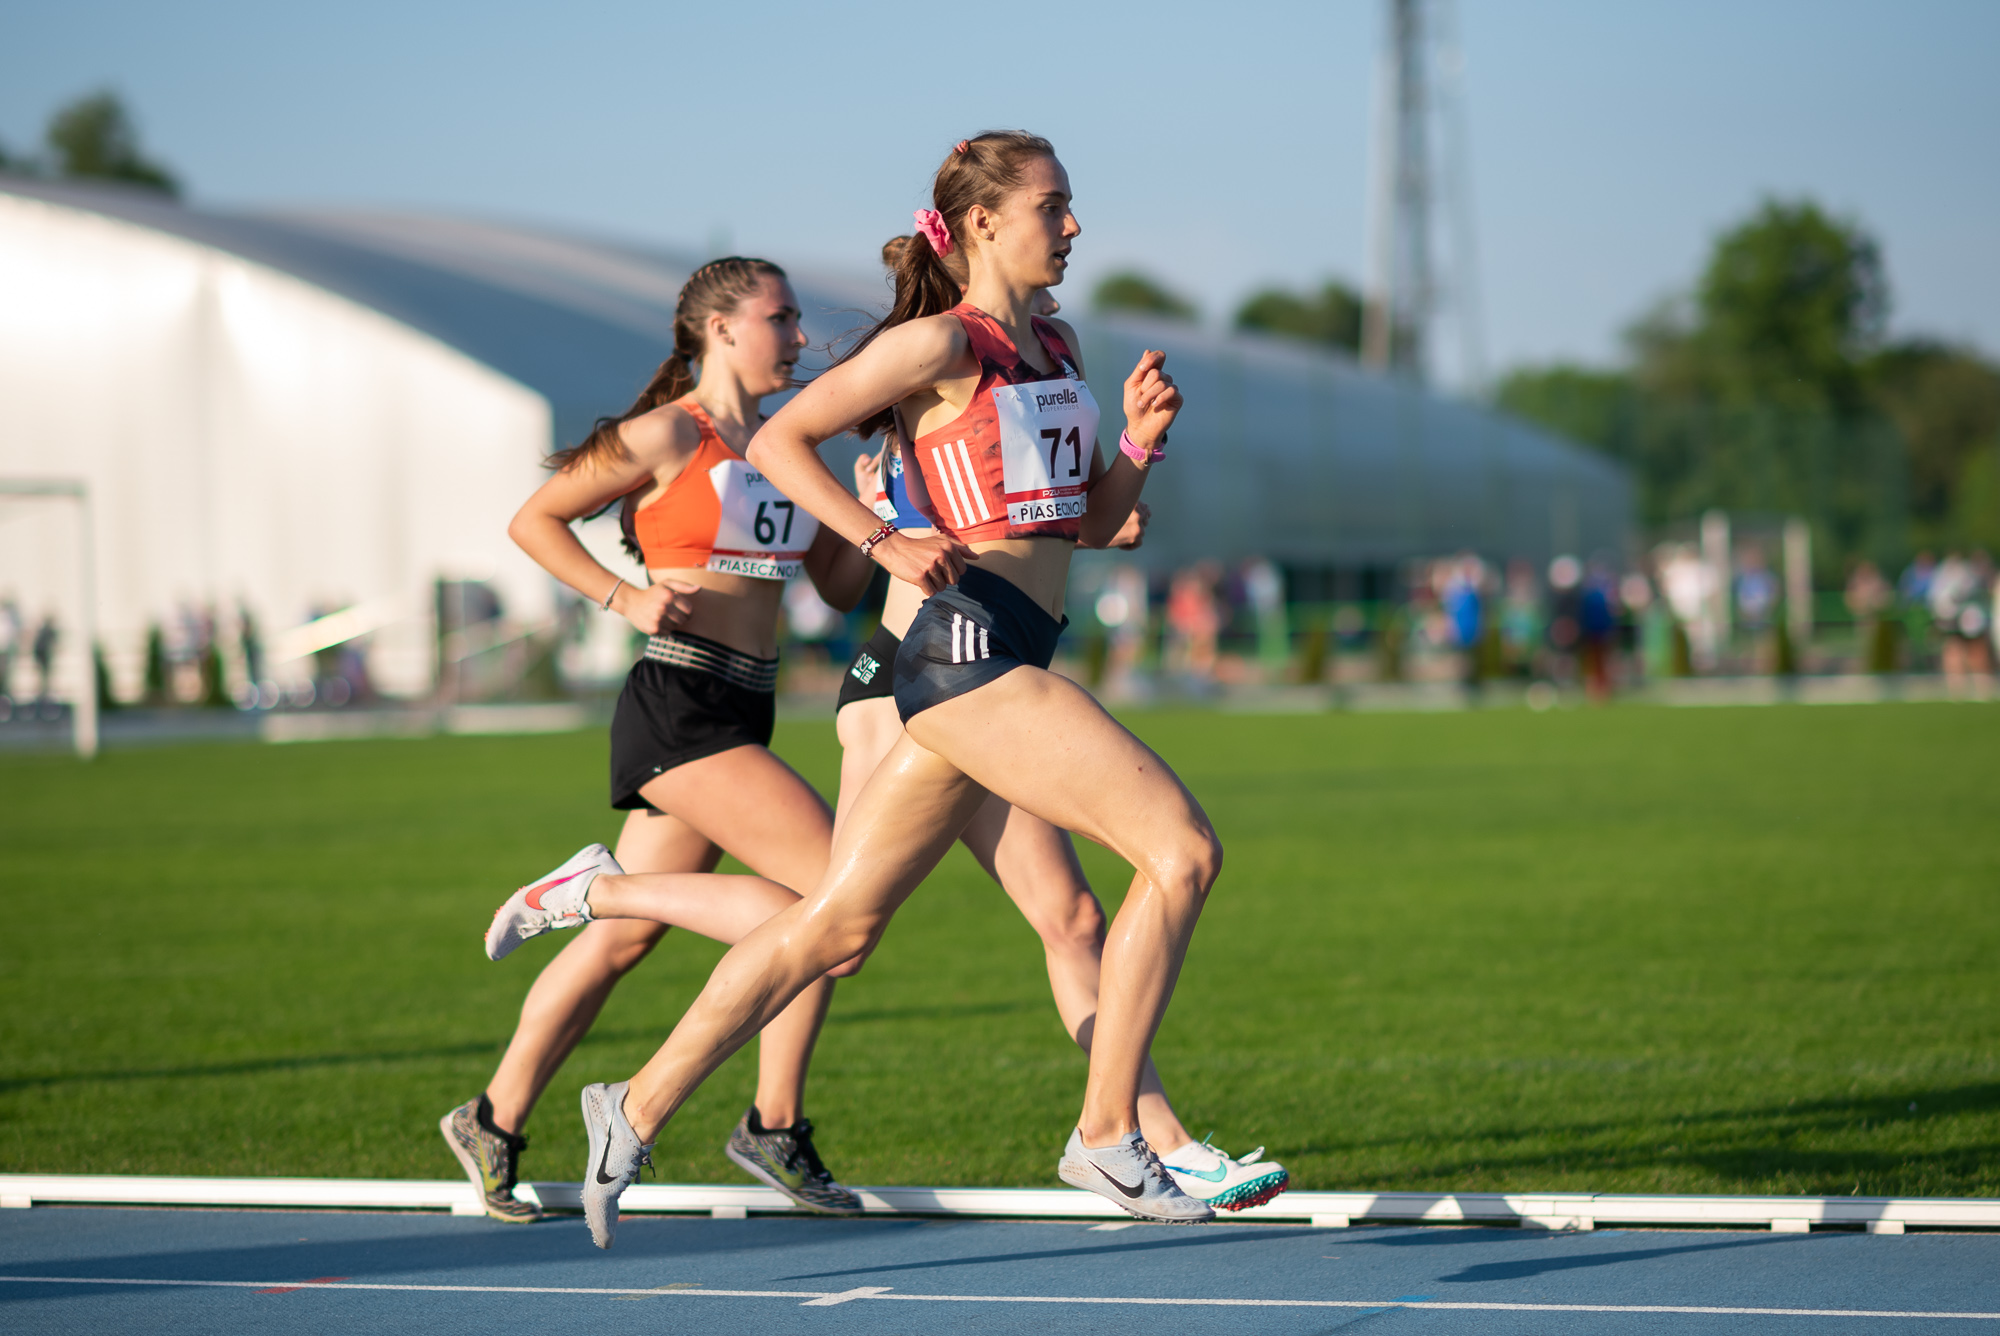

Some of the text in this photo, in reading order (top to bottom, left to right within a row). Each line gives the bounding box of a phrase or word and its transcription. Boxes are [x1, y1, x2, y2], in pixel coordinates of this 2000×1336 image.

[1036, 388, 1078, 413] purella
[1043, 404, 1080, 413] SUPERFOODS
[1040, 425, 1082, 479] 71
[745, 473, 769, 488] pur
[1042, 489, 1059, 498] PZU
[754, 501, 795, 545] 67
[719, 559, 793, 578] PIASECZNO
